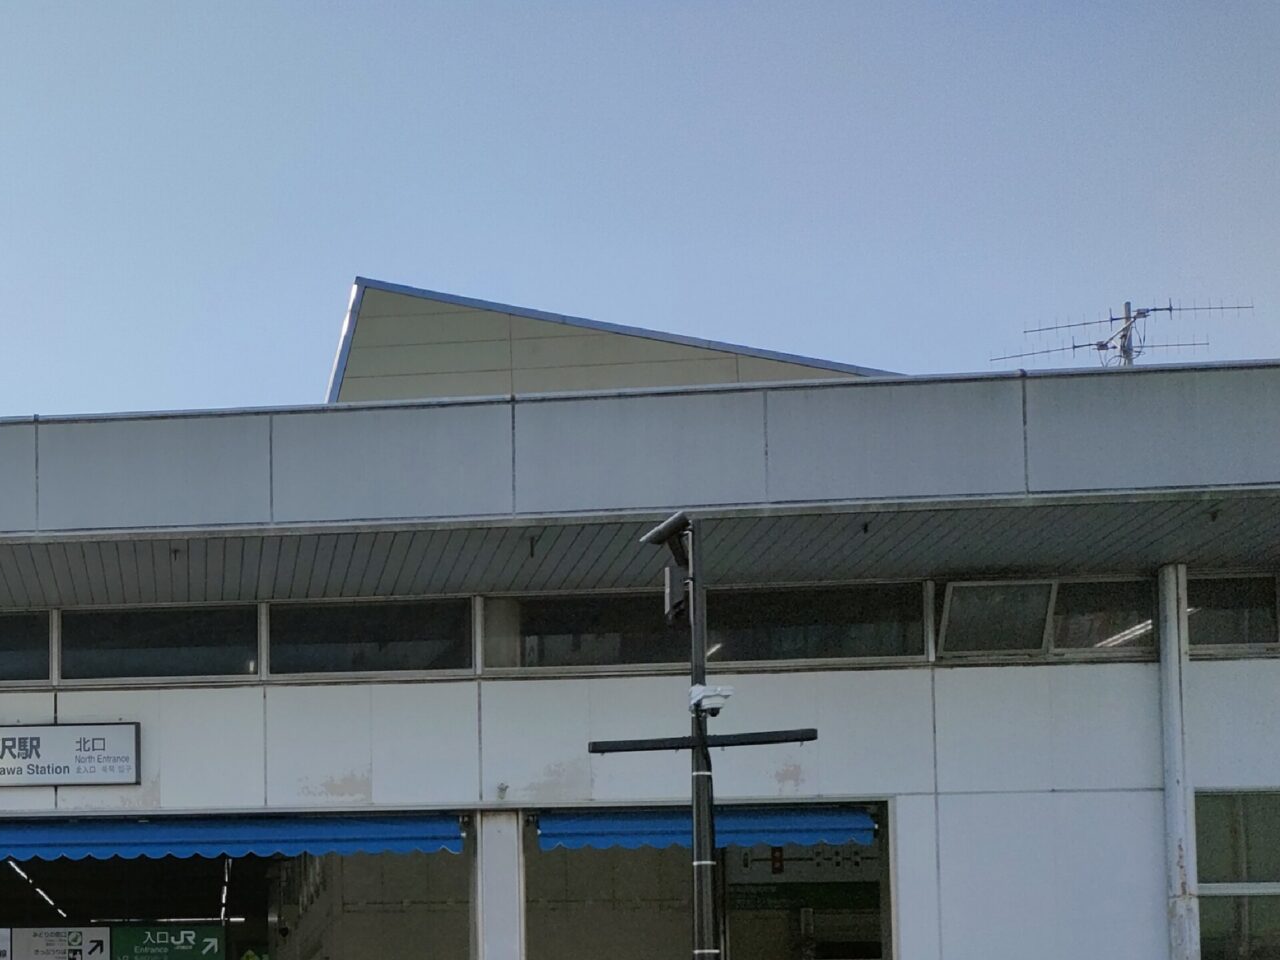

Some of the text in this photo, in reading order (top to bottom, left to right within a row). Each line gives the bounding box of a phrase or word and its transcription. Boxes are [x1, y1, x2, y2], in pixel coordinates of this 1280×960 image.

[75, 737, 106, 752] 北口
[75, 754, 130, 764] North Entrance
[26, 763, 70, 776] Station
[143, 930, 196, 945] 入口 JR
